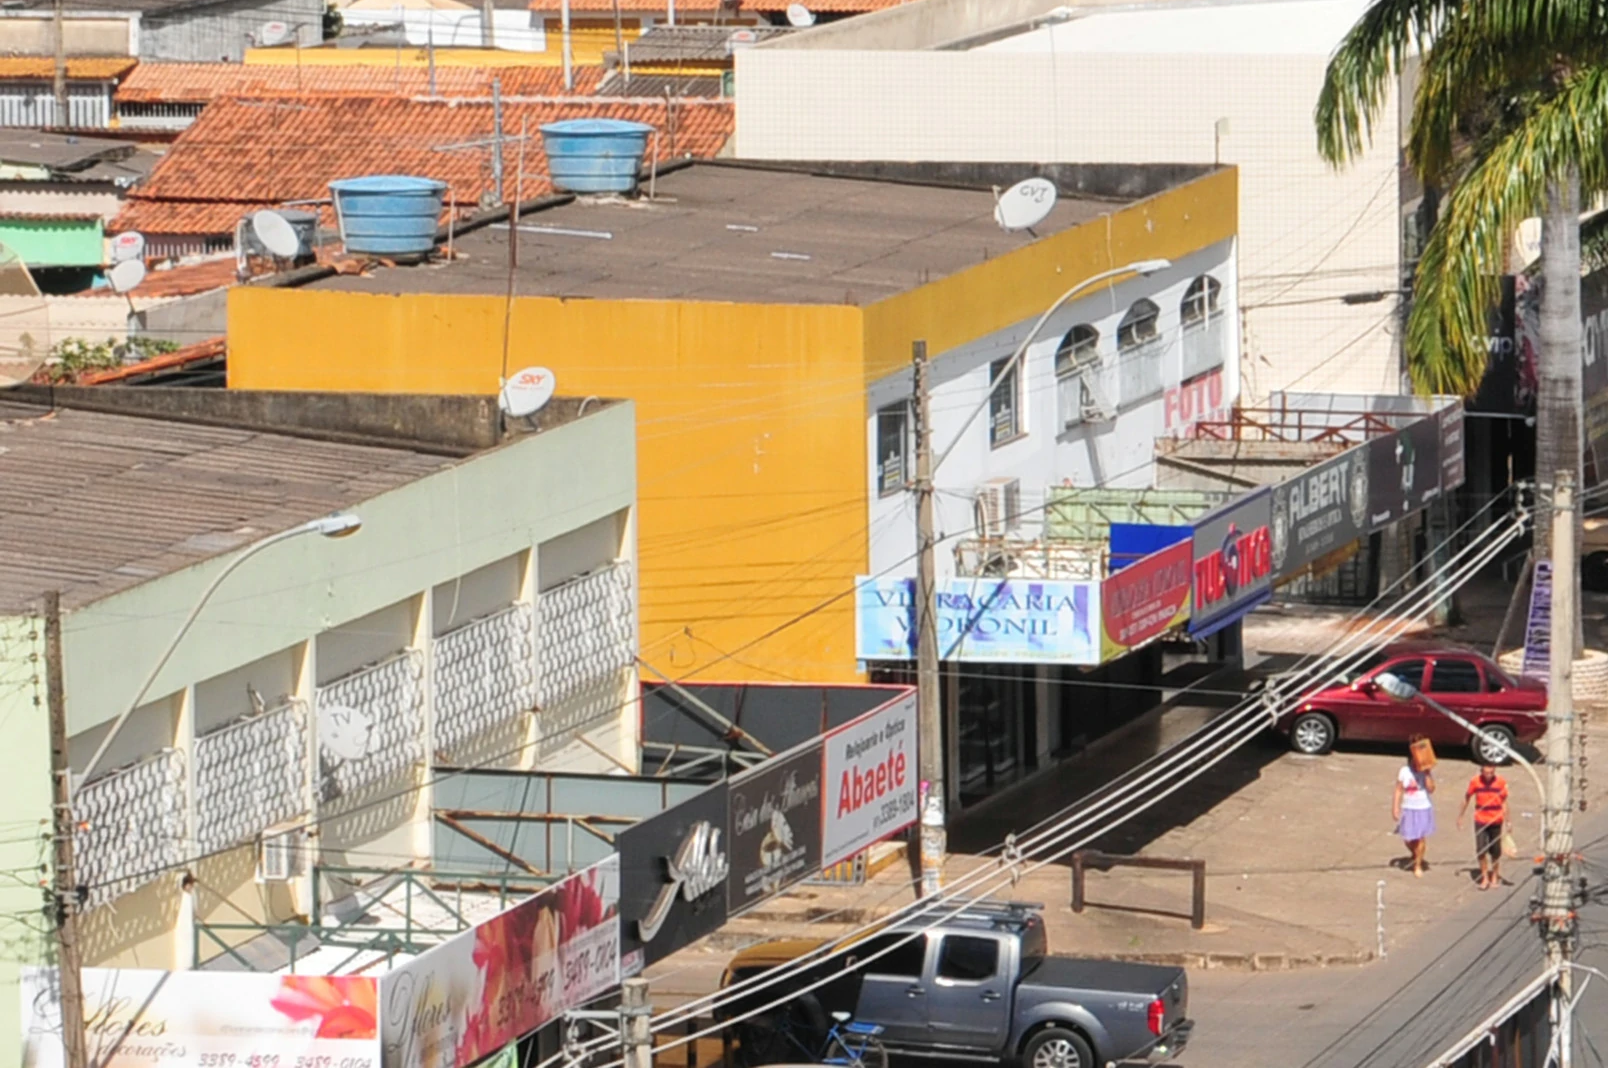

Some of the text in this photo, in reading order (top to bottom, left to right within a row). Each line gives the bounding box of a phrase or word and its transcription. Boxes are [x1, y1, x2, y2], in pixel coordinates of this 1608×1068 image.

[1163, 371, 1223, 429] FOTO
[1289, 461, 1349, 529] ALBERT
[874, 589, 1077, 613] VIRAÇARIA
[330, 711, 351, 727] TV
[837, 739, 906, 820] Abaeté
